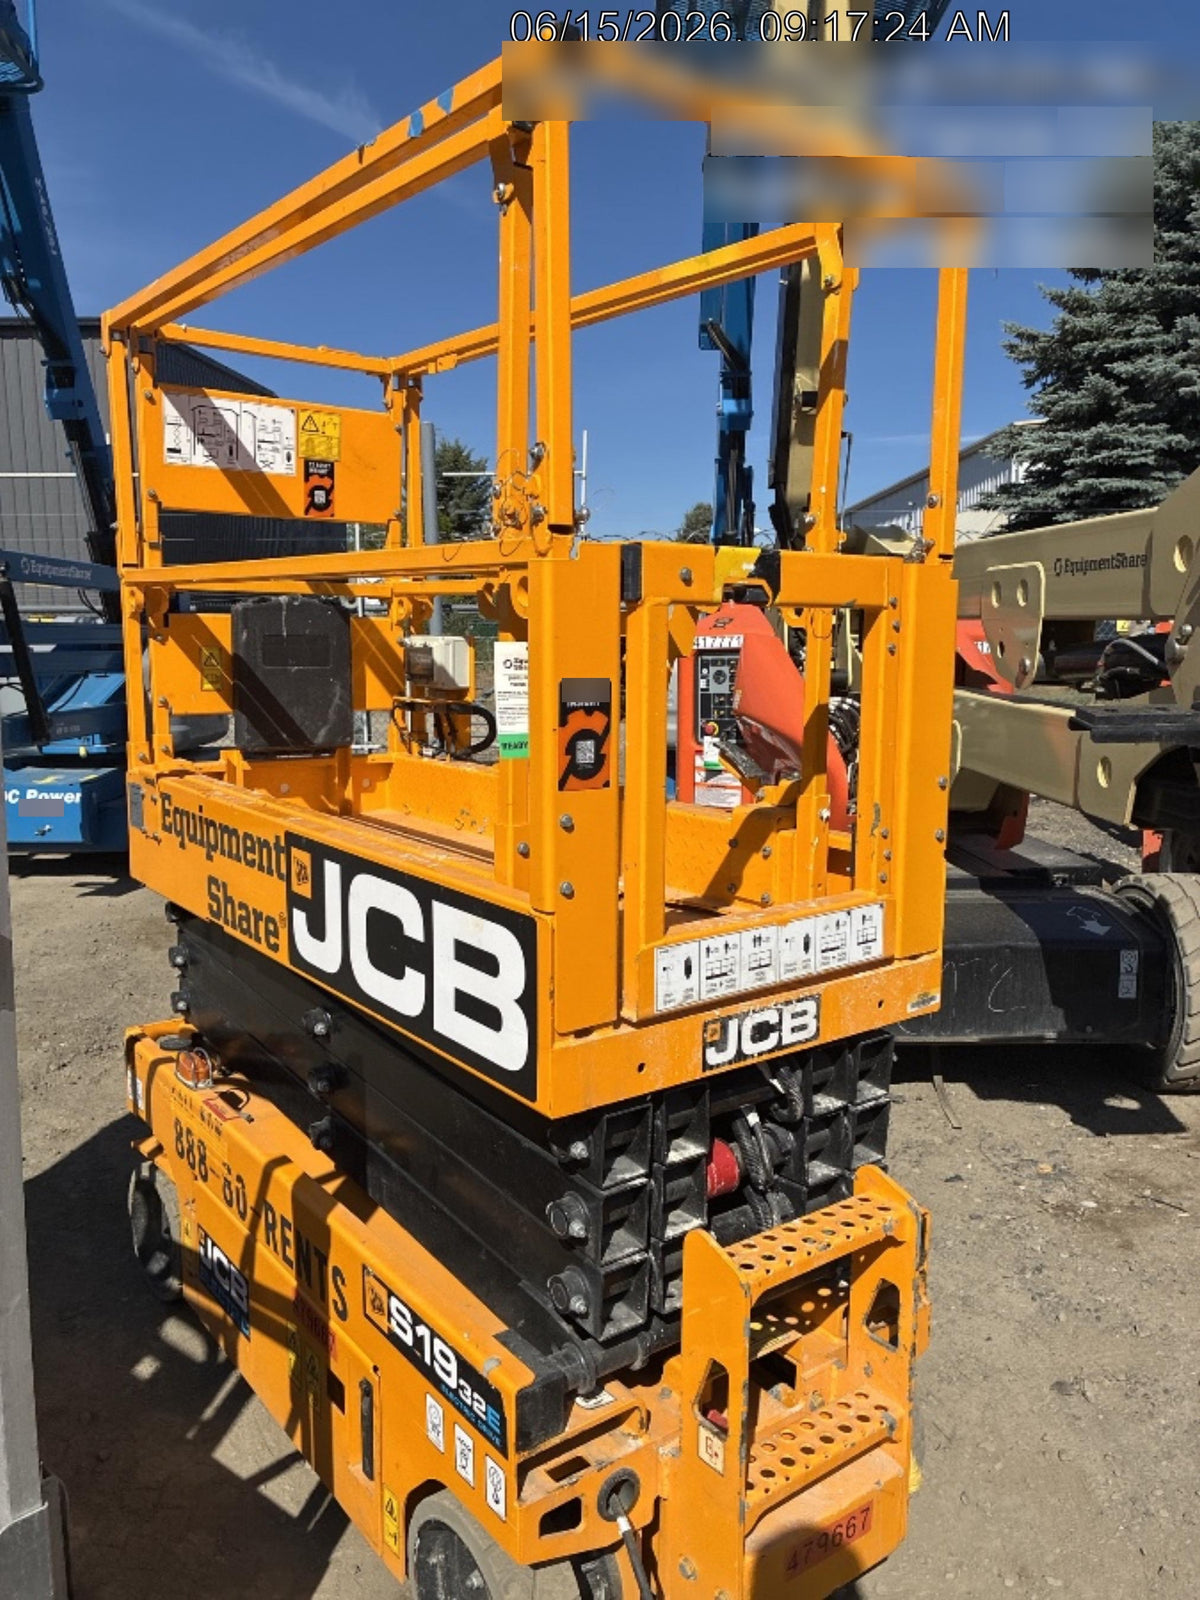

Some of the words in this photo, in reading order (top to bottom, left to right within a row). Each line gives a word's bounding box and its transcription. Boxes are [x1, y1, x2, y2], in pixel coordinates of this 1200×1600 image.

[1064, 552, 1148, 576] EquipmentShare
[159, 793, 285, 882] Equipment
[293, 859, 529, 1071] JCB
[705, 1000, 818, 1066] JCB
[200, 1236, 249, 1313] JCB
[785, 1507, 871, 1573] 479667
